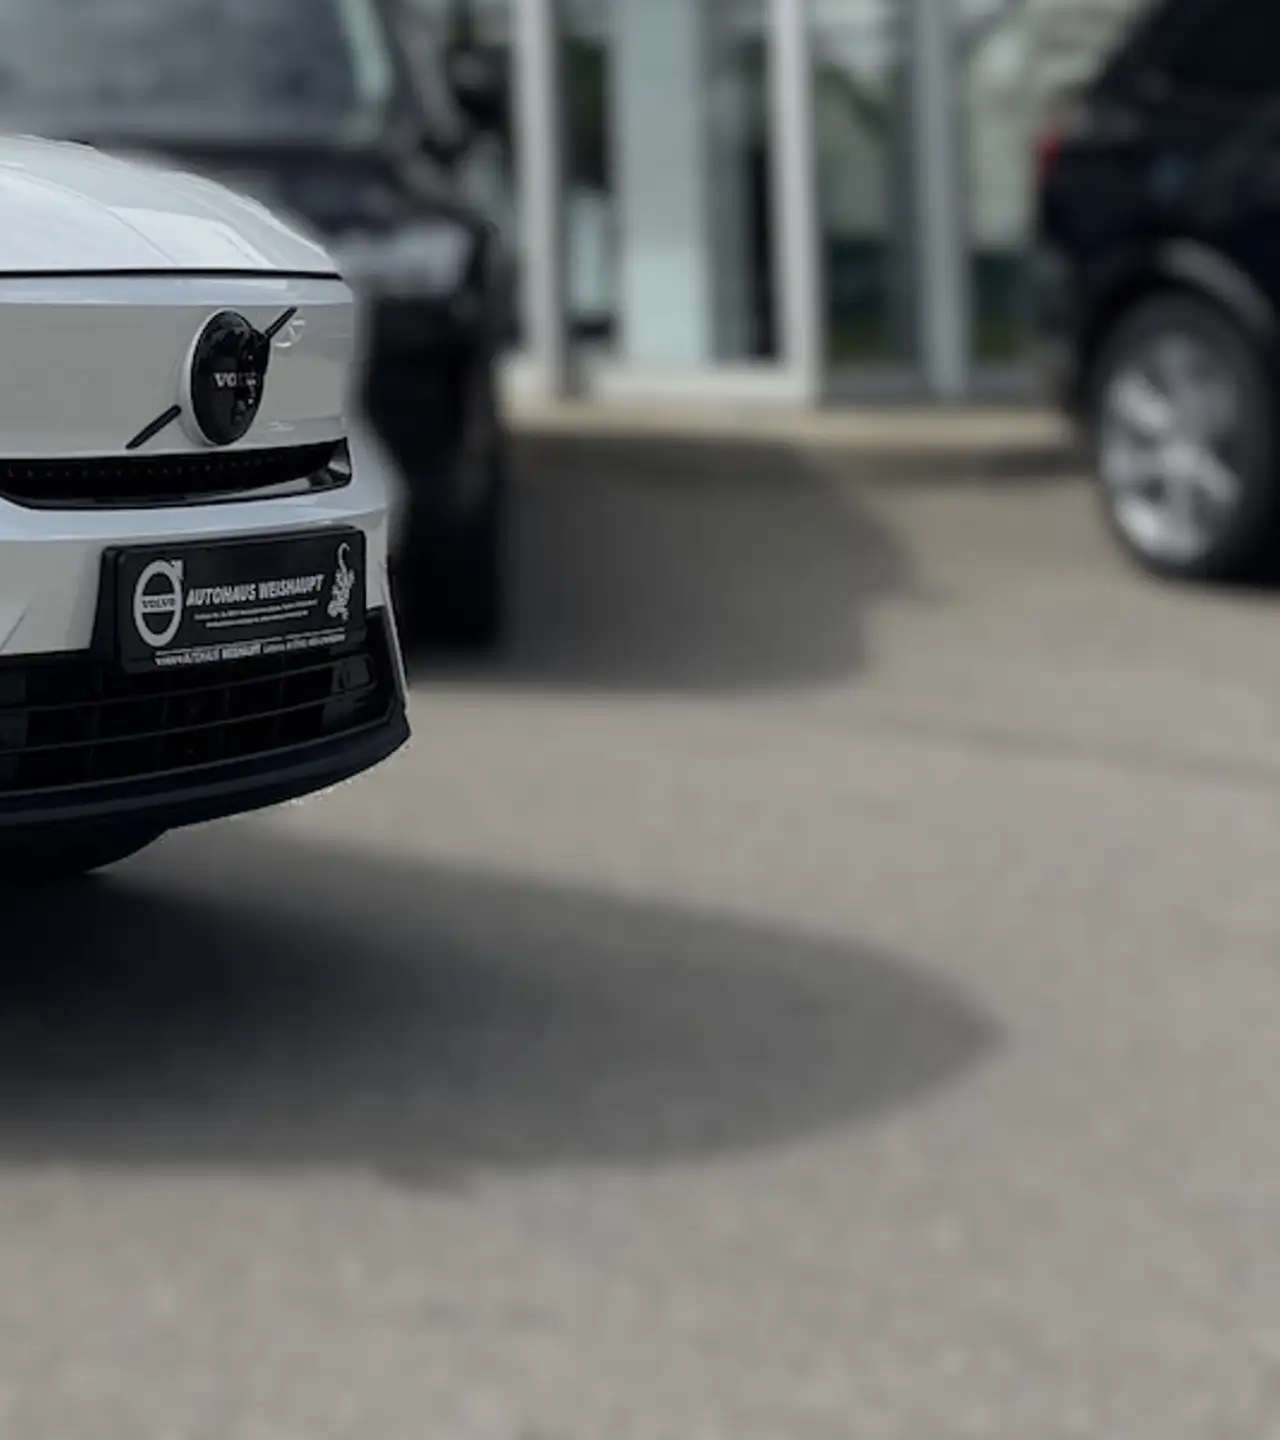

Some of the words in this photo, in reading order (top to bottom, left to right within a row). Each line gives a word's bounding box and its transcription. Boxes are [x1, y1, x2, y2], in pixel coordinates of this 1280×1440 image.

[212, 372, 259, 388] VOV
[186, 583, 256, 606] AUTOHAUS
[258, 574, 324, 600] WEISHAUPT
